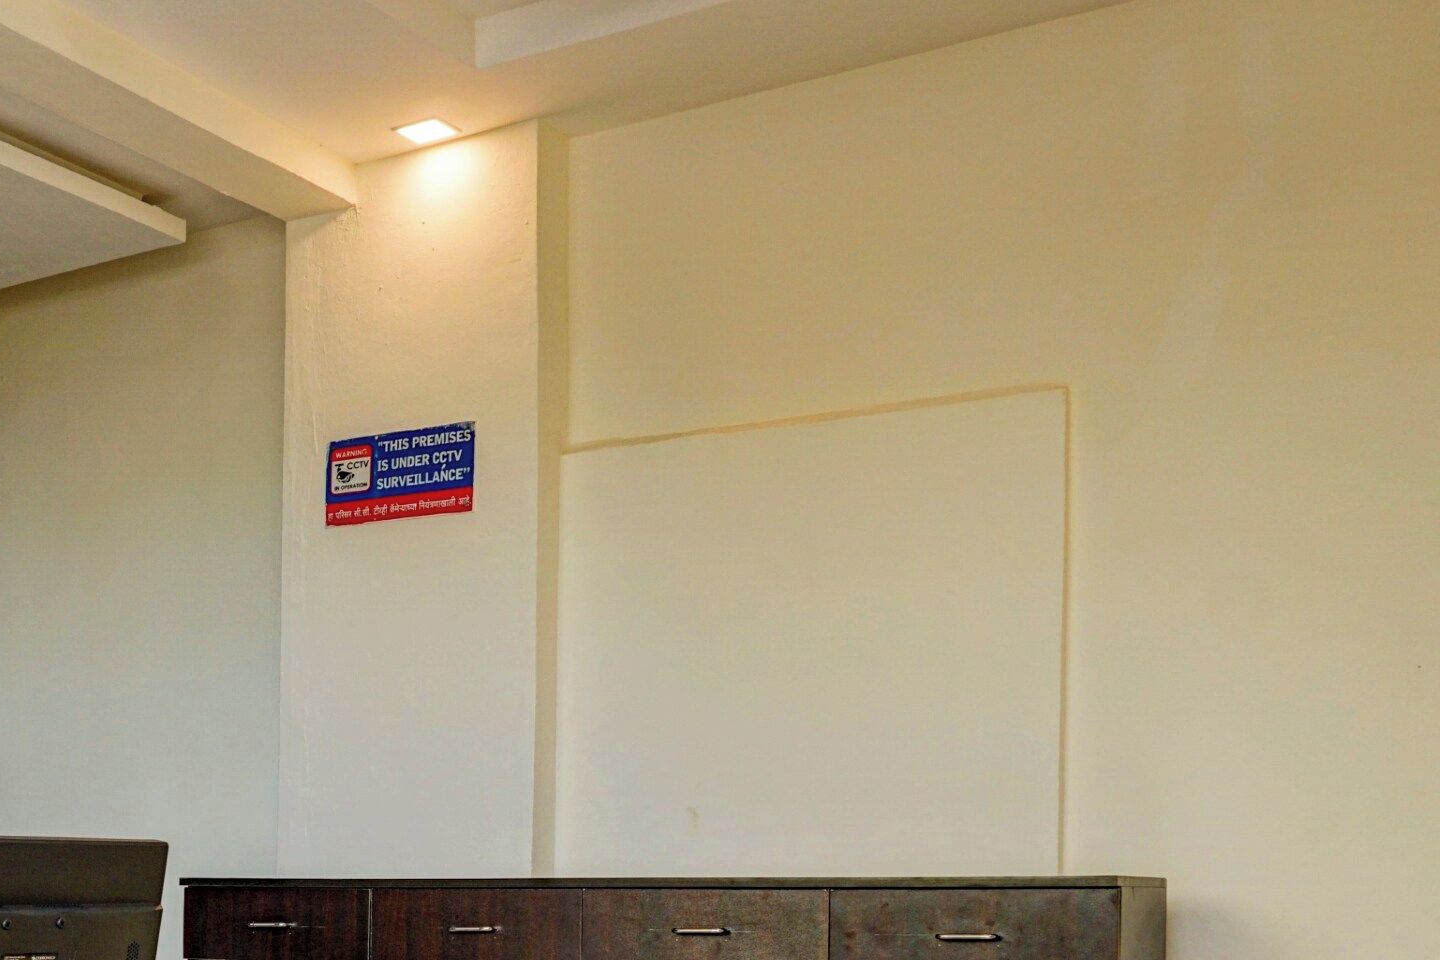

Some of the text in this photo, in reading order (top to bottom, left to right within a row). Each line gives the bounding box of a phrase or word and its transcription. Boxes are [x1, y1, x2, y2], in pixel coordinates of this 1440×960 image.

[412, 429, 471, 449] PREMISES
[335, 448, 368, 459] WARNING
[346, 460, 370, 470] CCTV
[377, 449, 463, 472] IS UNDER CCTV
[340, 482, 368, 491] OPERATION
